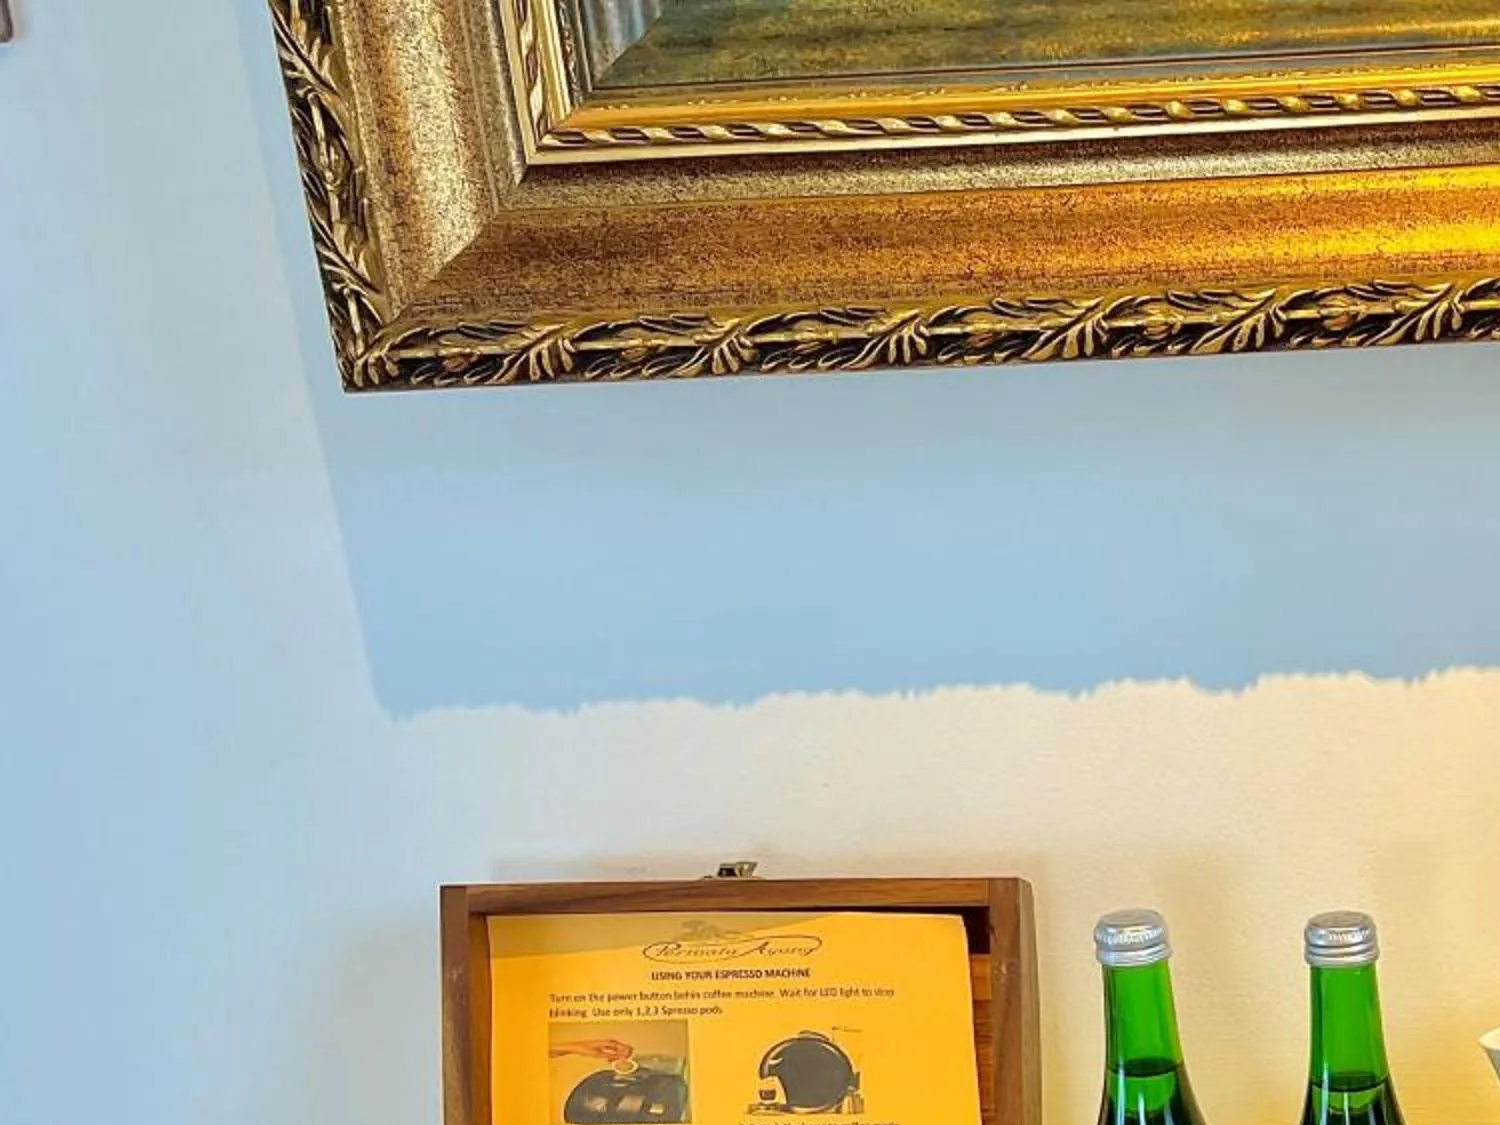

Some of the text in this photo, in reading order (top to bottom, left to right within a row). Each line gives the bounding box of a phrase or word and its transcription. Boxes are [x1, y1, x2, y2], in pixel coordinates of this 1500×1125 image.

[652, 968, 811, 981] USING YOUR ESPRESSO MACHINE
[588, 992, 604, 1001] the
[639, 991, 672, 1000] button
[703, 989, 732, 999] coffee
[592, 1008, 612, 1017] Use
[613, 1007, 633, 1017] only
